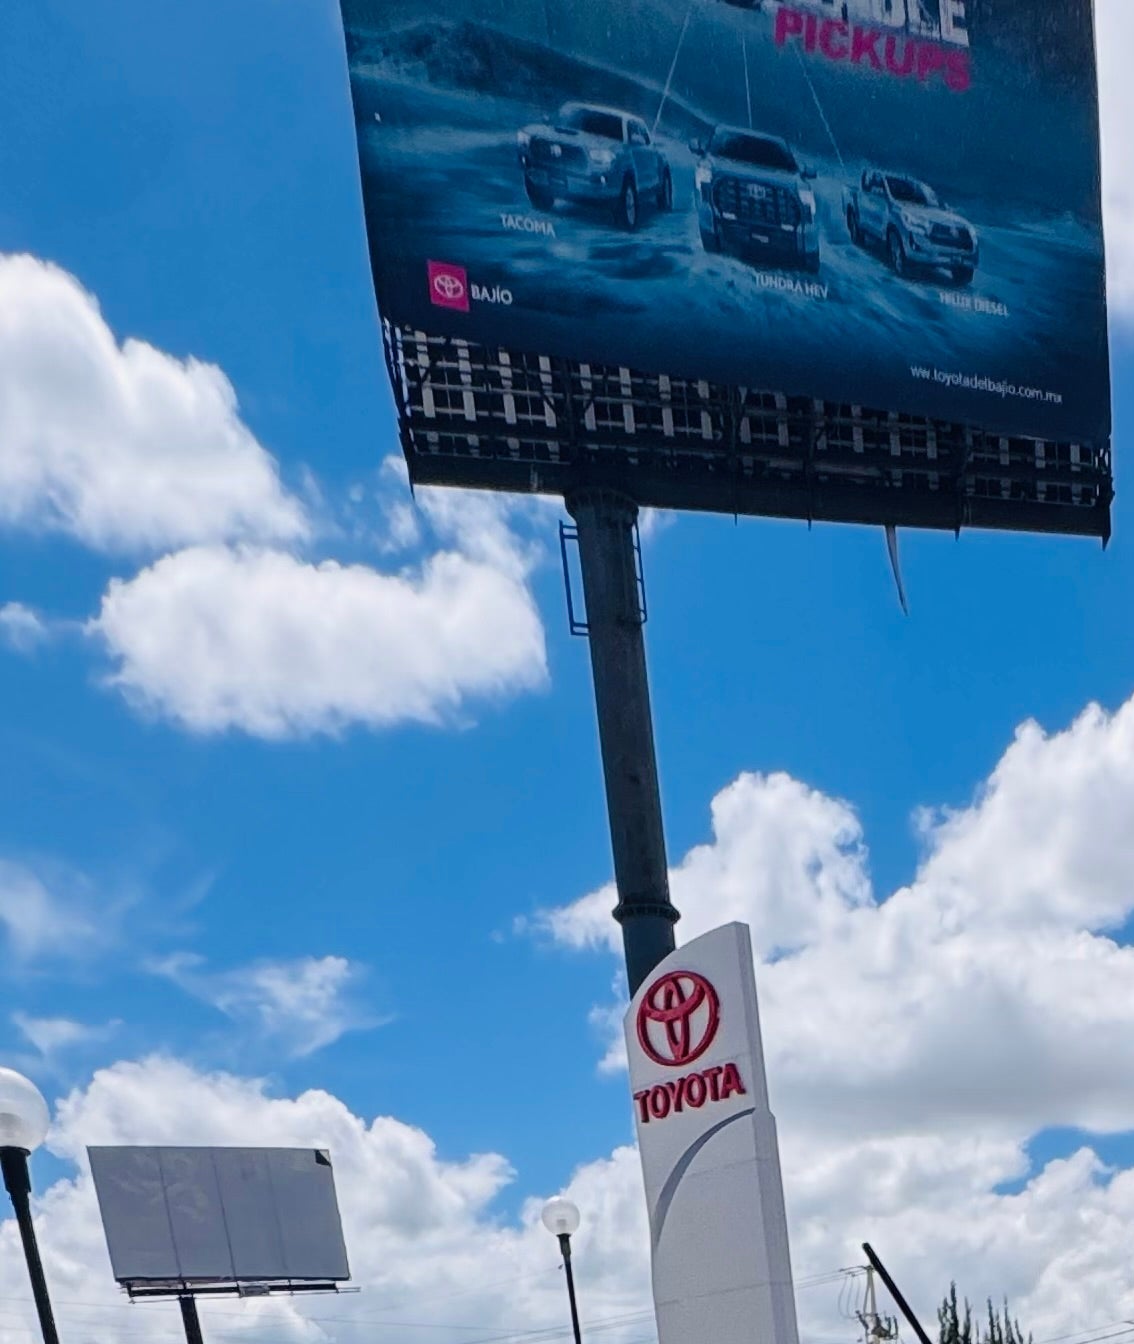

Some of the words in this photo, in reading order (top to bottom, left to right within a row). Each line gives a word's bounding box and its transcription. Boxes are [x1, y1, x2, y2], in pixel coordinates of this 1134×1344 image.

[774, 7, 971, 92] PICKUPS
[500, 213, 556, 238] TACOMA
[471, 283, 514, 306] BAJÍO
[754, 273, 802, 296] TUNDRA
[633, 1063, 747, 1123] TOYOTA
